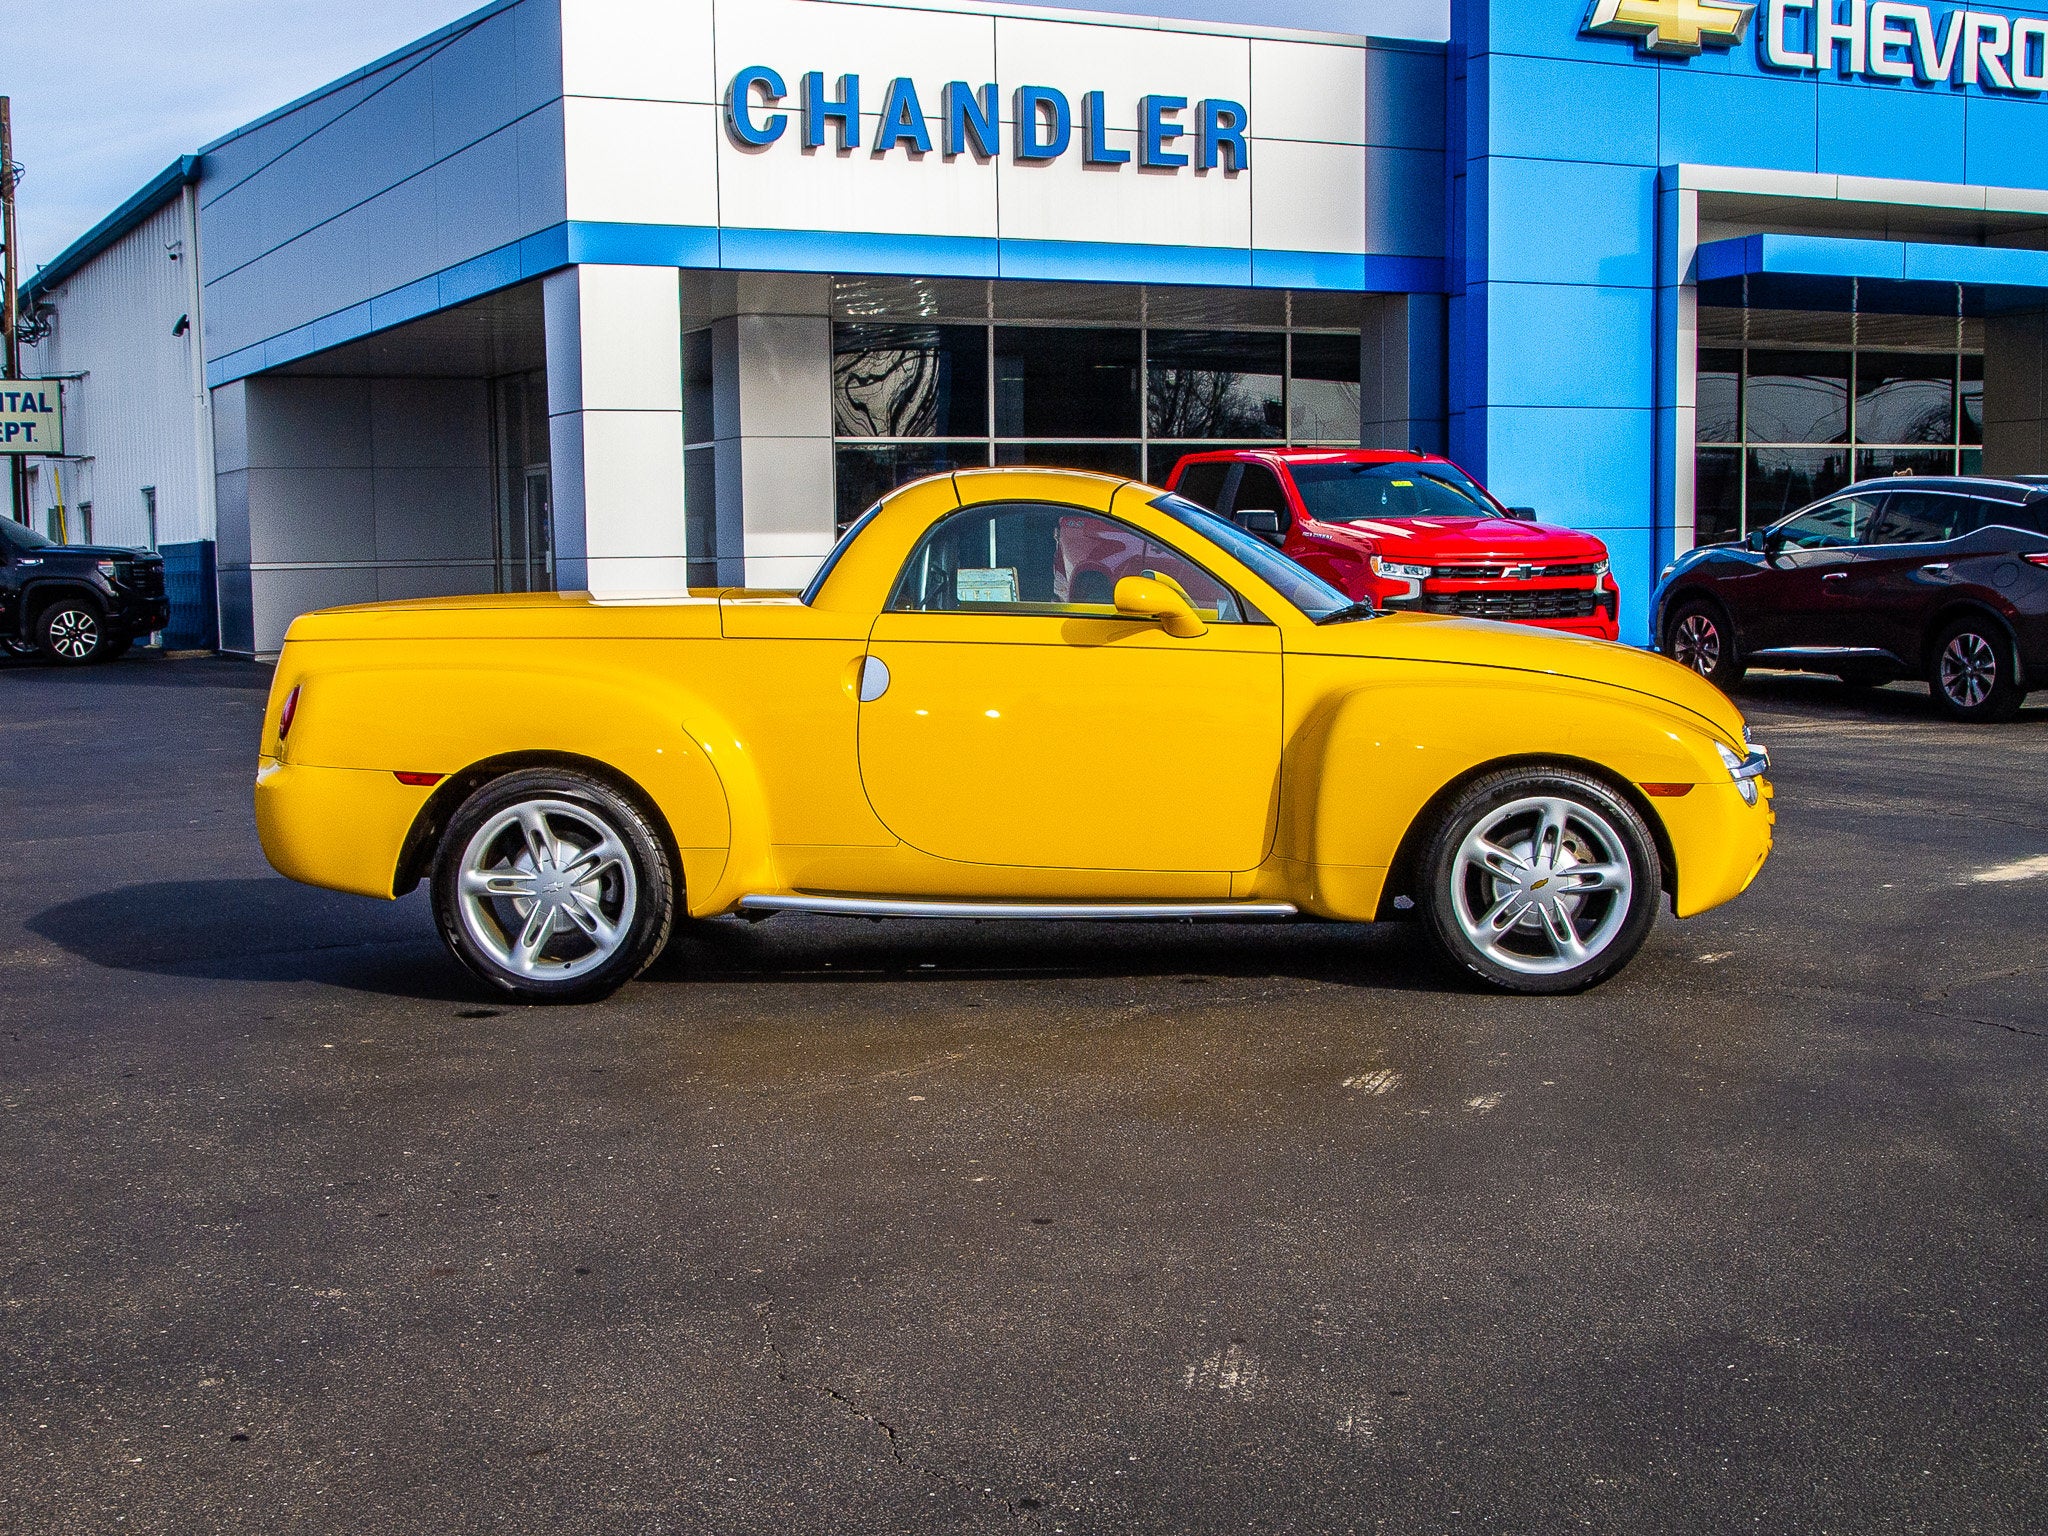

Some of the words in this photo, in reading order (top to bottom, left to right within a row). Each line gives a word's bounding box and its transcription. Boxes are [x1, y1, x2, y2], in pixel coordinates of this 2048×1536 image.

[1761, 0, 2048, 91] CHEVRO
[726, 65, 1249, 171] CHANDLER
[0, 392, 53, 413] TAL
[0, 421, 38, 442] PT.
